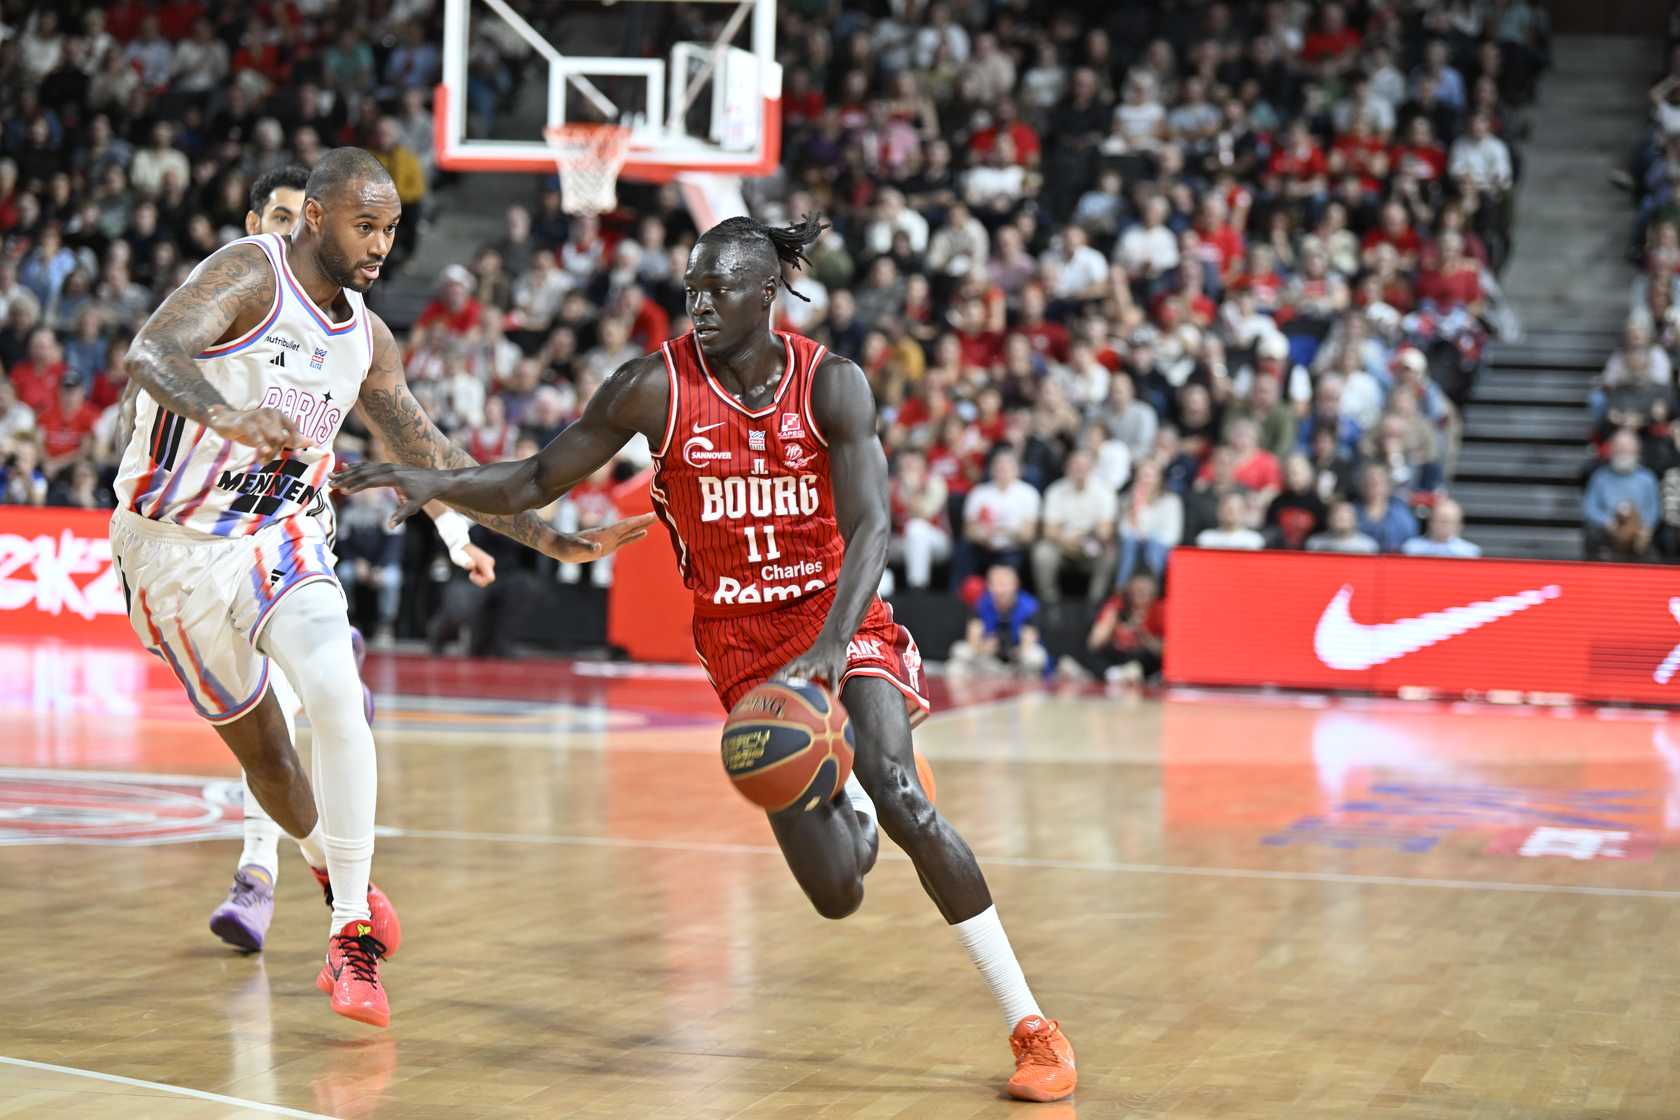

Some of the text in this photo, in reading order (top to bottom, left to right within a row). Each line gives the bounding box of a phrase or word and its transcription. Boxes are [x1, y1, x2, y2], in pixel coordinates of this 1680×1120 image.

[691, 451, 732, 460] SANNOVER
[217, 470, 316, 505] MENNEN
[698, 474, 819, 522] BOURG
[744, 525, 781, 563] 11
[761, 560, 823, 581] Charles
